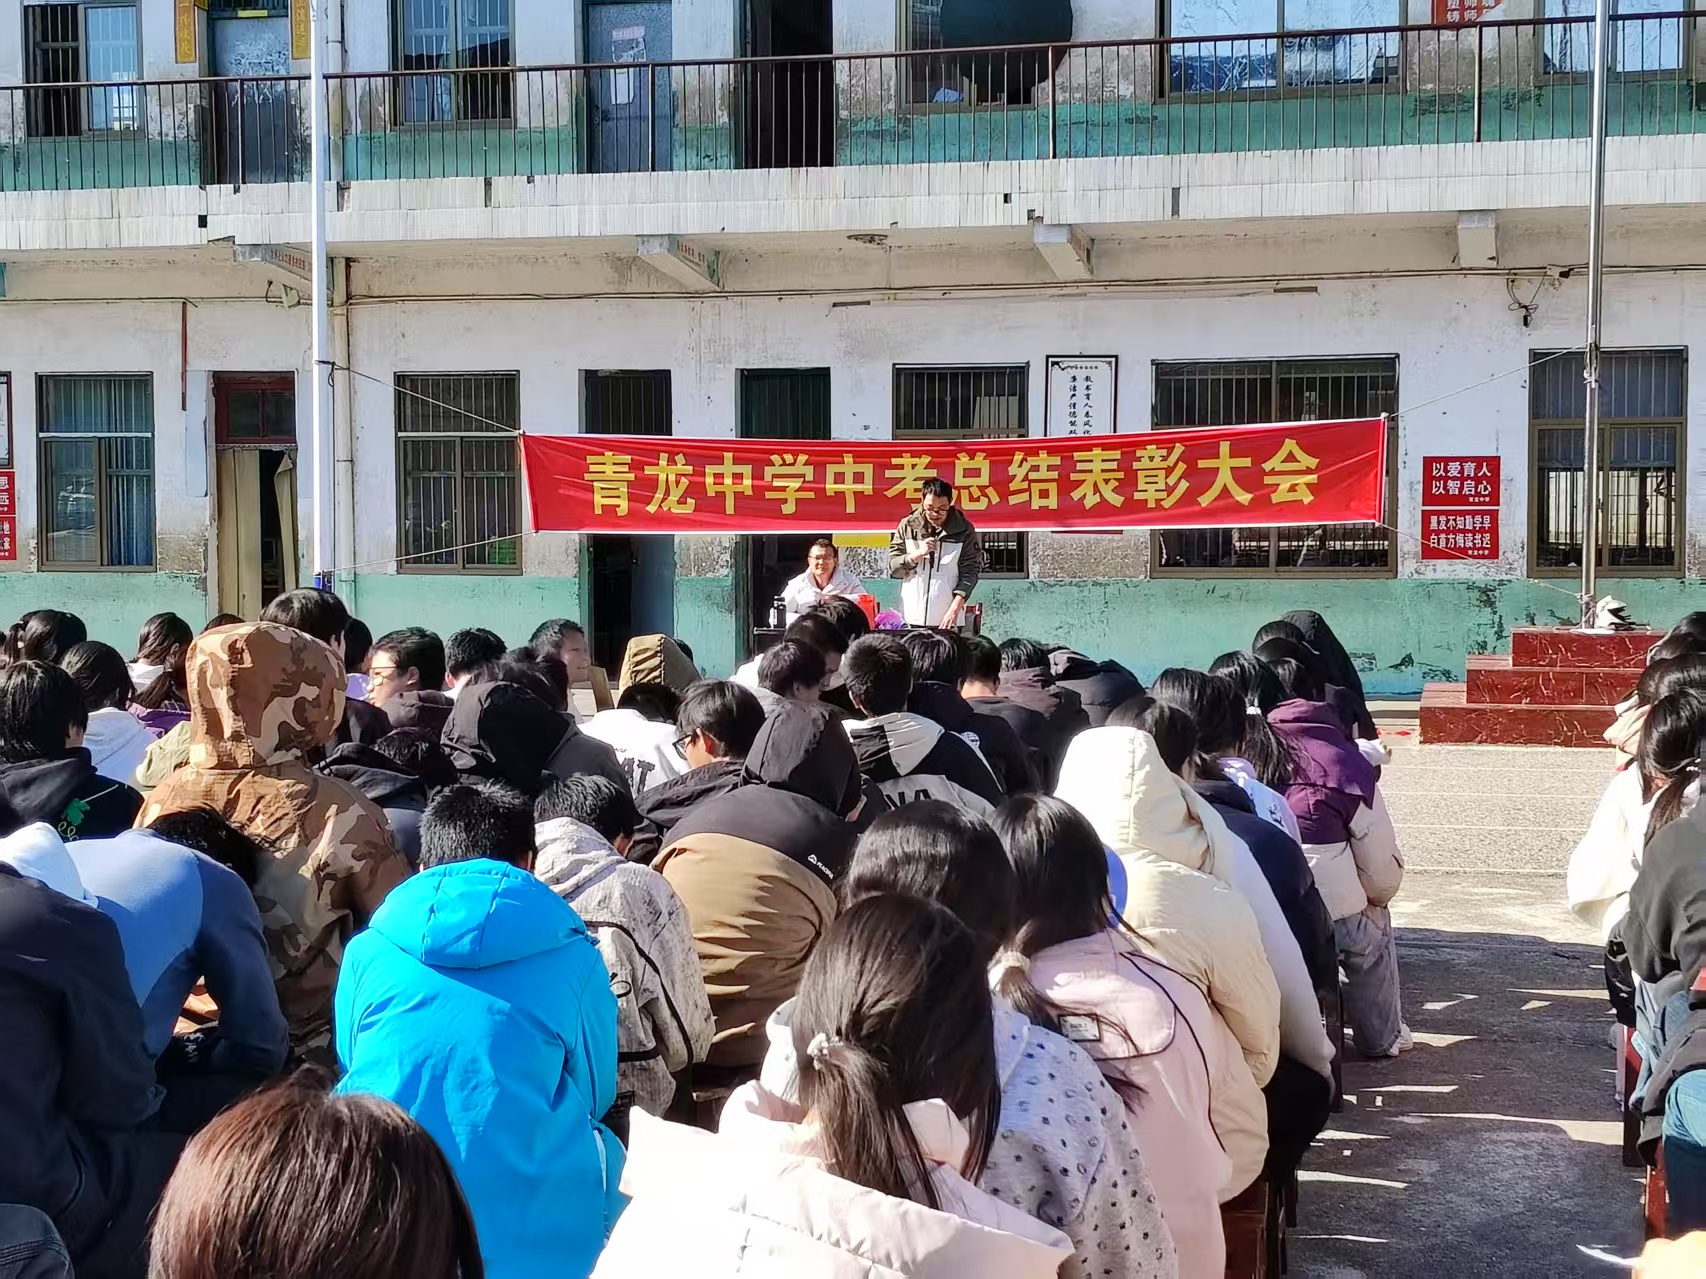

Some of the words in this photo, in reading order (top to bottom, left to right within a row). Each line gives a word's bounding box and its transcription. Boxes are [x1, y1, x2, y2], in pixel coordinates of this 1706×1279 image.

[584, 438, 1320, 517] 青龙中学中考总结表彰大会
[1432, 462, 1492, 477] 以爱育人
[1432, 480, 1492, 495] 以智启心
[1430, 514, 1492, 530] 黑发不知勤学早
[1430, 532, 1492, 548] 白首方悔读书迟
